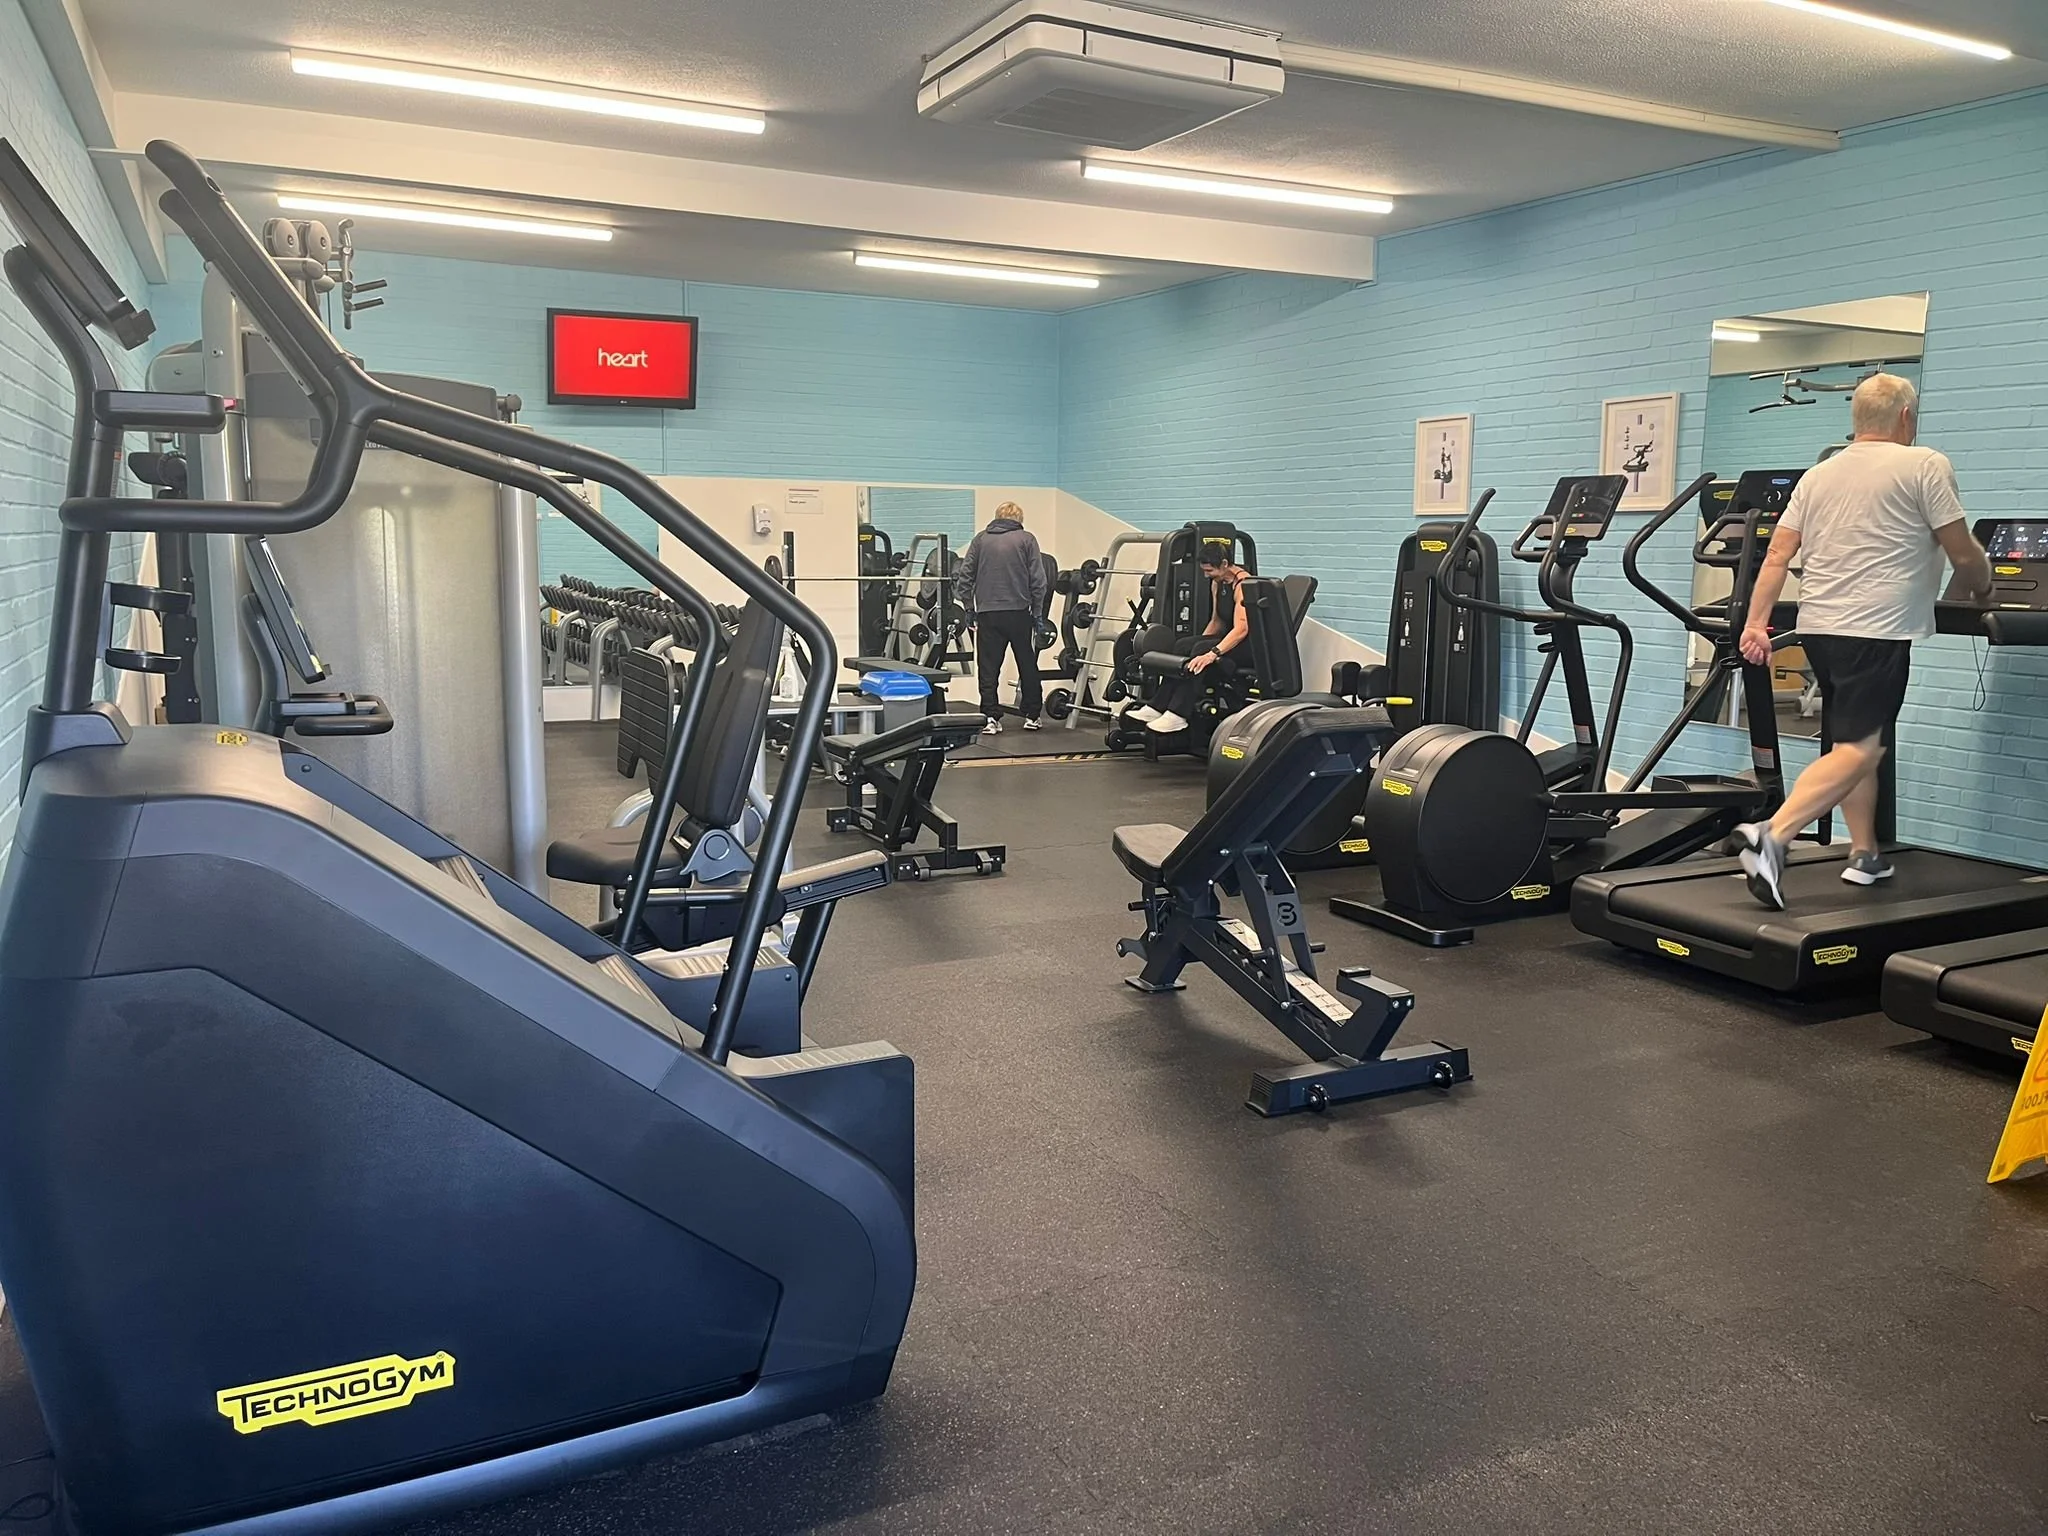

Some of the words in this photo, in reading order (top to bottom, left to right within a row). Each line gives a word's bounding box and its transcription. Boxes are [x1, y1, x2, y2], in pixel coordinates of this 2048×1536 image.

[598, 347, 648, 368] heart
[1340, 840, 1368, 851] TECHNOG
[1814, 947, 1856, 962] TECHNOGYM
[223, 1360, 445, 1424] TECHNOGYM
